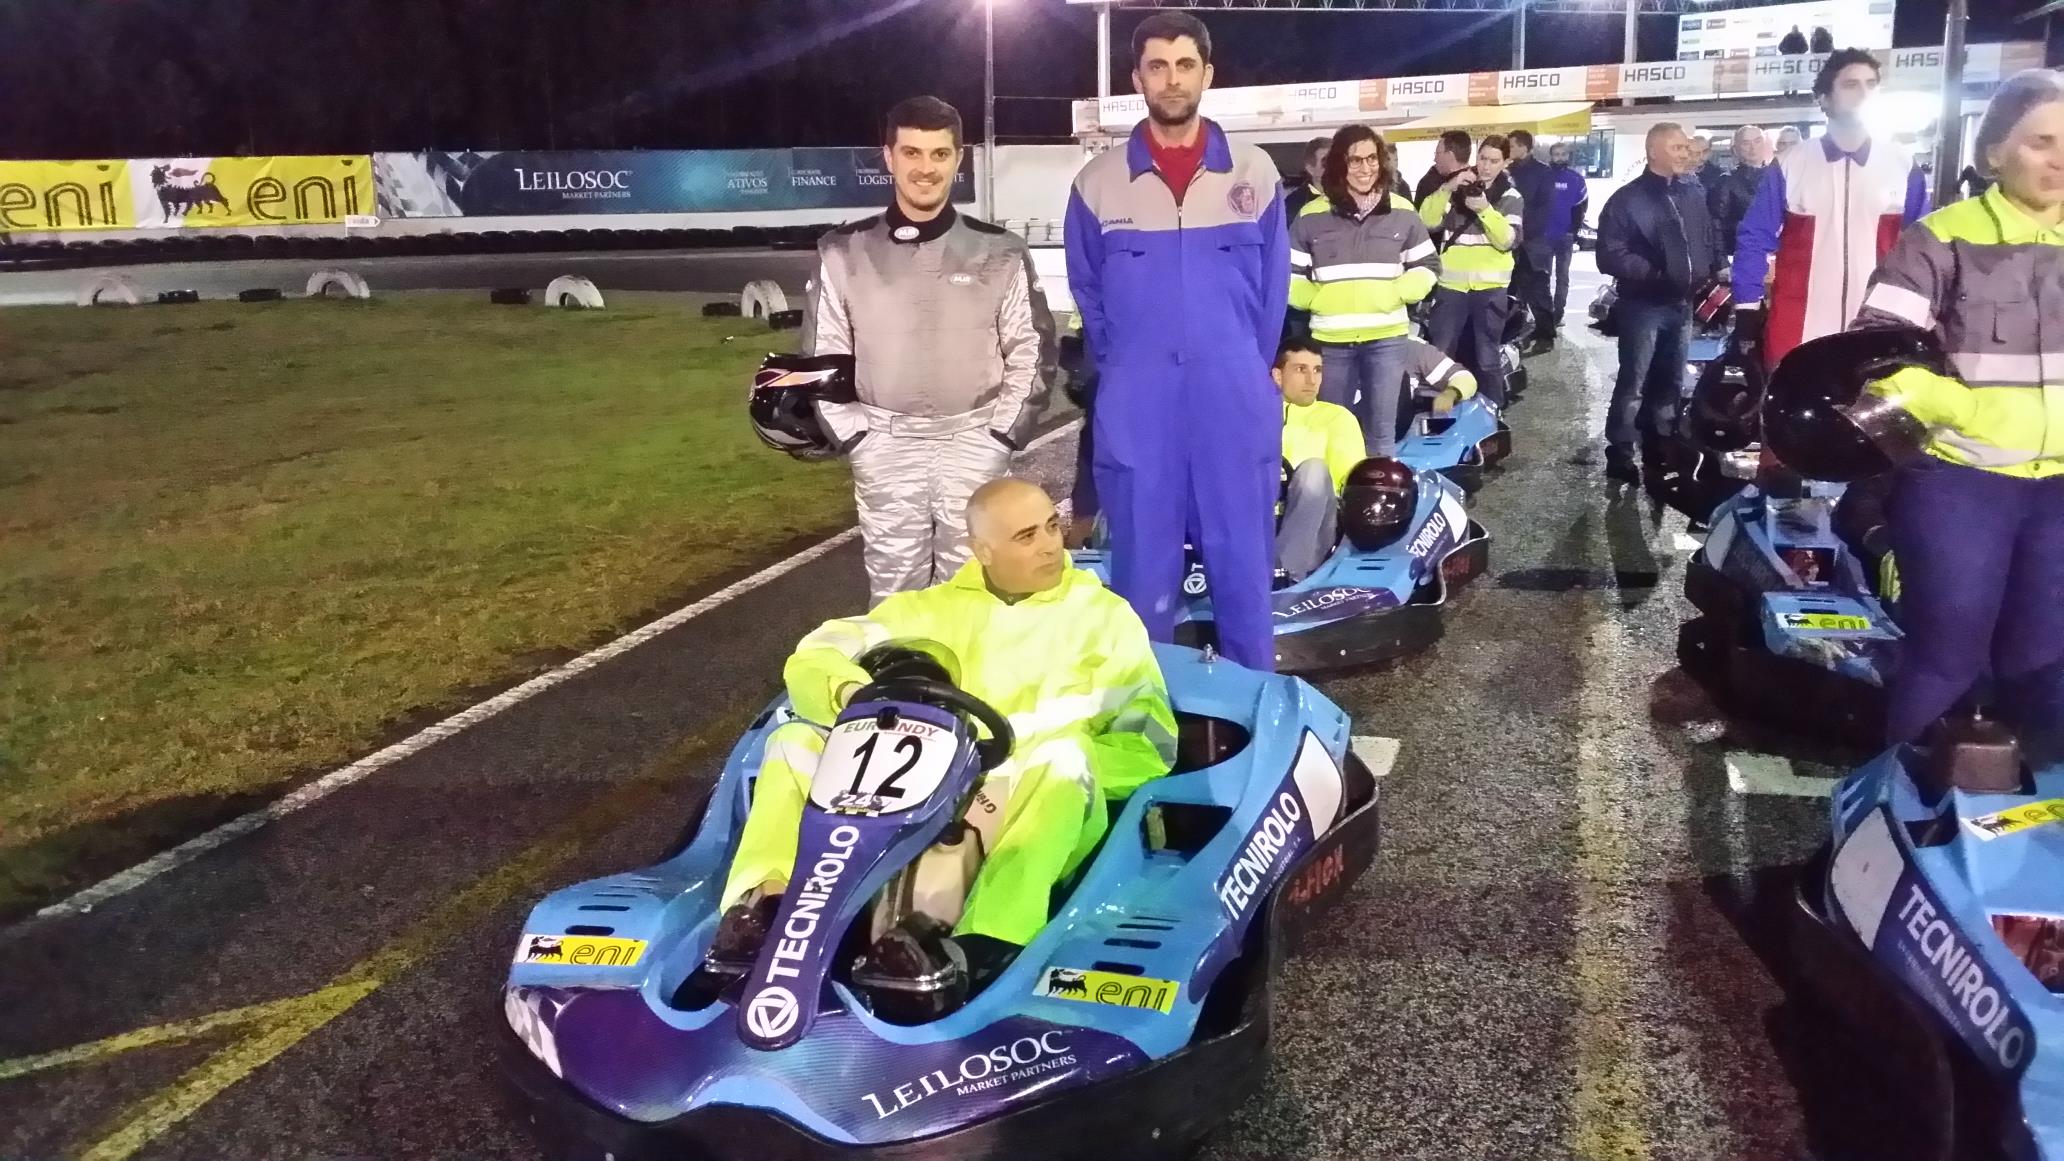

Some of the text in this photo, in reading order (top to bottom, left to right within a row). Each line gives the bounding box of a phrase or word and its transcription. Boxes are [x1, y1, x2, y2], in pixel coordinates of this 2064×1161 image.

[1392, 80, 1444, 95] HASCO
[1504, 73, 1560, 88] HASCO
[1624, 67, 1686, 82] HASCO
[1102, 101, 1145, 113] HASCO
[247, 159, 358, 220] eni
[514, 168, 630, 190] LEILOSOC
[728, 178, 768, 189] ATIVOS
[792, 176, 837, 186] FINANCE
[859, 174, 894, 185] LOGIST
[0, 164, 117, 228] eni
[850, 732, 923, 799] 12
[1220, 792, 1301, 921] TECNIROLO
[766, 825, 860, 983] TECNIROLO
[570, 939, 640, 966] eni
[1897, 883, 2024, 1070] TECNIROLO
[1096, 979, 1171, 1011] eni
[862, 1030, 1072, 1119] LEILOSOC
[956, 1055, 1077, 1096] MARKET PARTNERS
